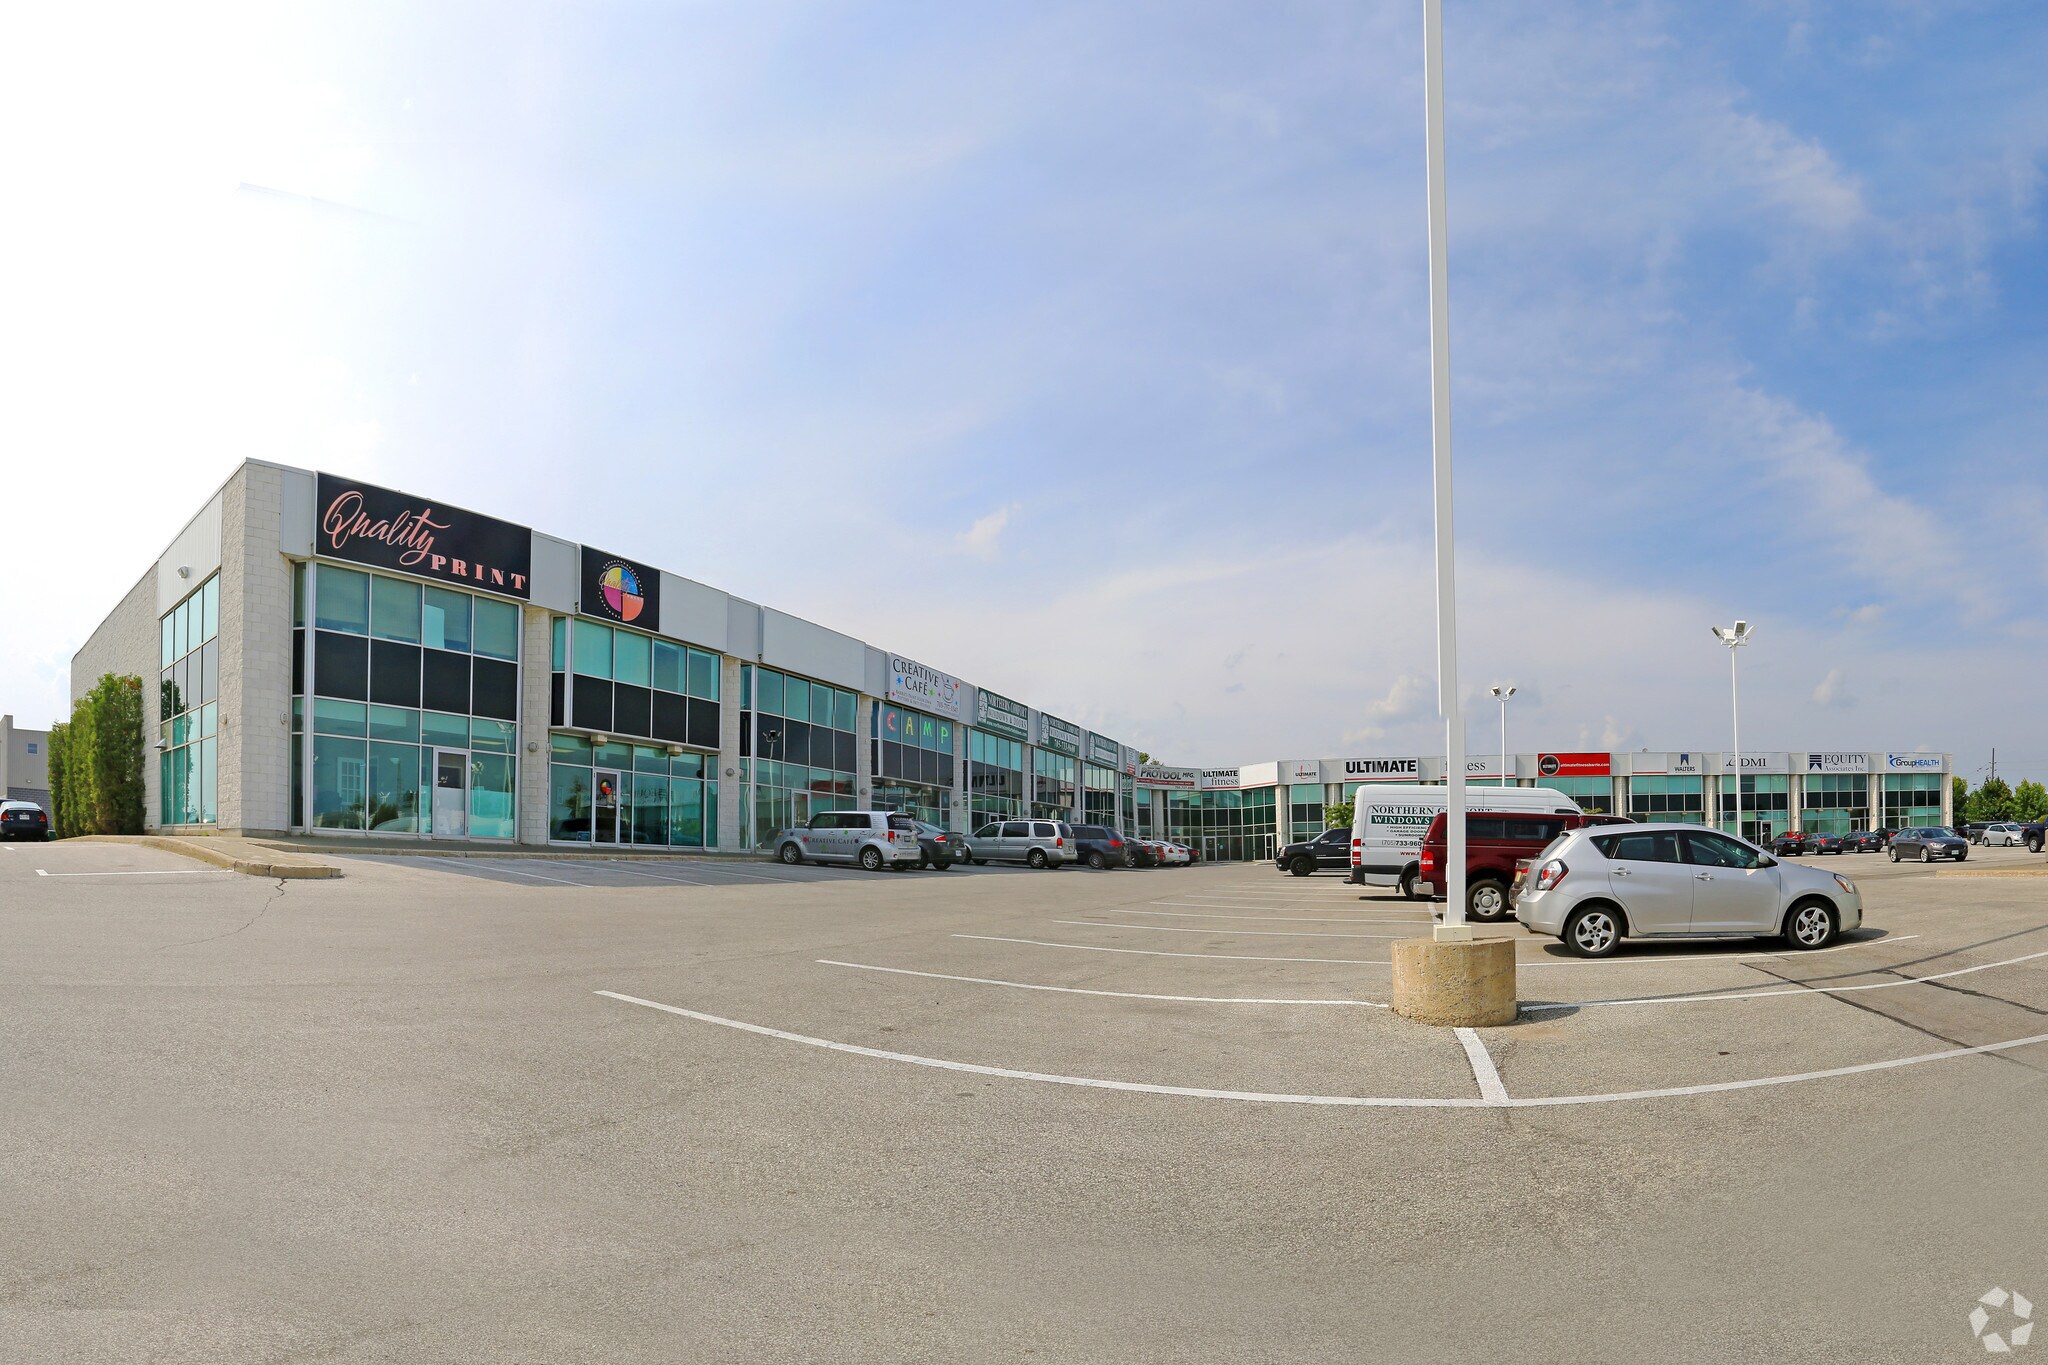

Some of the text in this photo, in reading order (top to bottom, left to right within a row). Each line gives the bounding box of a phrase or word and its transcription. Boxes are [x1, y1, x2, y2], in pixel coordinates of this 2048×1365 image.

[323, 491, 451, 565] Quality
[430, 553, 526, 590] PRINT
[892, 658, 940, 687] CREATIVE
[905, 676, 928, 696] CAFÉ
[1824, 754, 1866, 765] EQUITY
[1896, 758, 1939, 768] GroupHEALTH
[1346, 760, 1417, 774] ULTIMATE
[1140, 769, 1182, 780] PROTOOL
[1202, 770, 1238, 778] ULTIMATE
[1211, 777, 1239, 786] fitness
[1371, 805, 1434, 815] NORTHERN
[1373, 816, 1430, 824] WINDOWS
